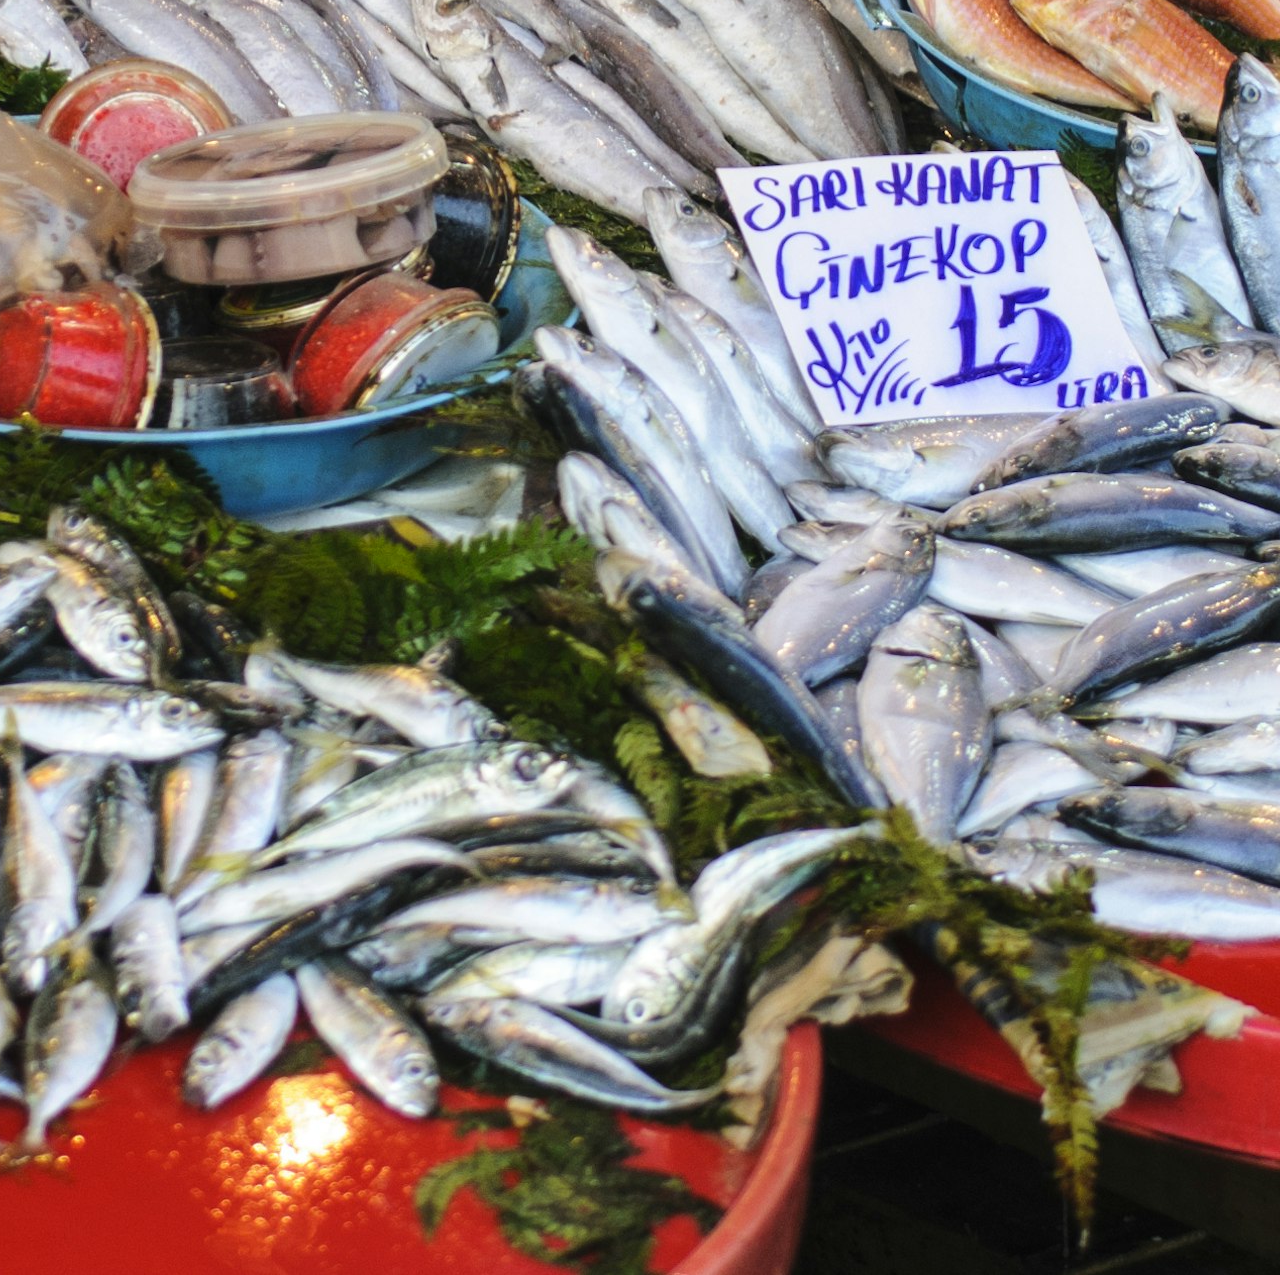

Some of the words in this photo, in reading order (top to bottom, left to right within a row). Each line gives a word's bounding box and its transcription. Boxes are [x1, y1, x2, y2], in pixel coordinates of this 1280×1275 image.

[743, 167, 867, 232] SARI
[876, 156, 1063, 207] KANAT
[931, 284, 1072, 388] 15
